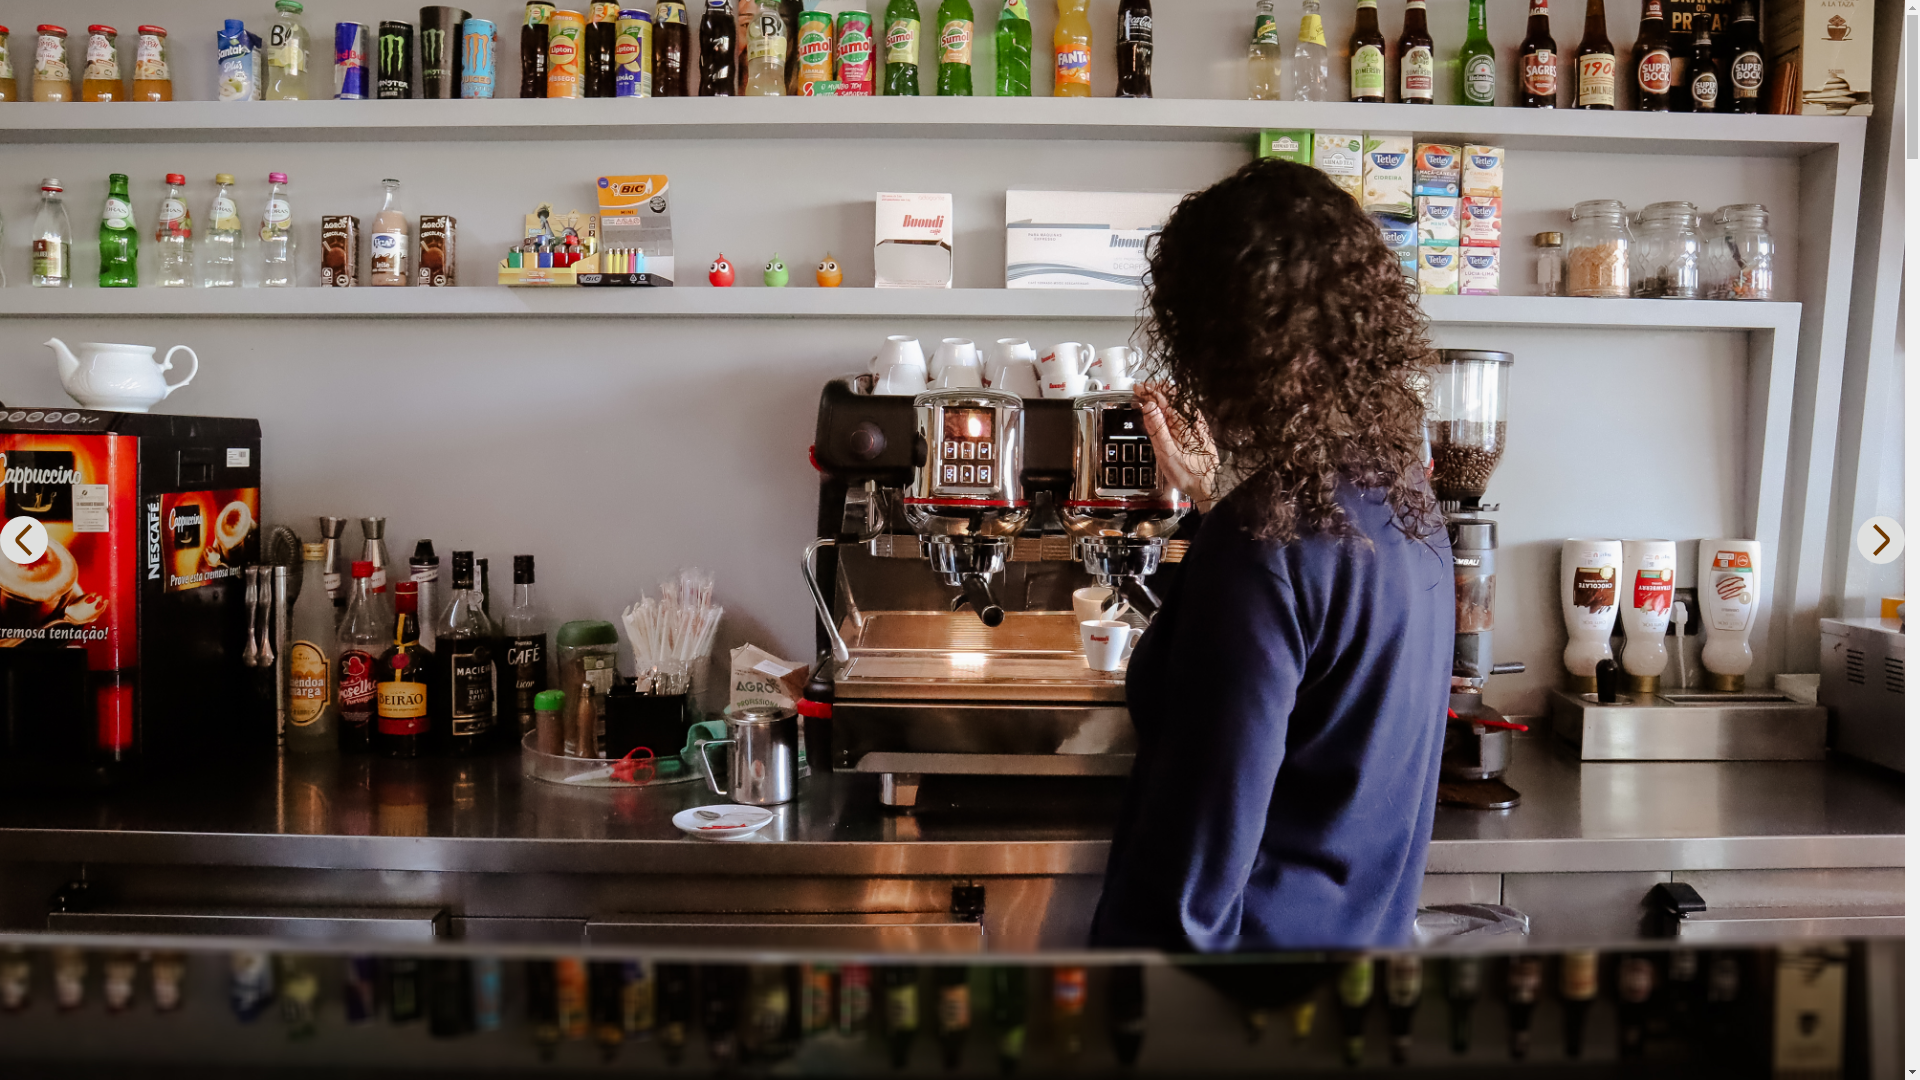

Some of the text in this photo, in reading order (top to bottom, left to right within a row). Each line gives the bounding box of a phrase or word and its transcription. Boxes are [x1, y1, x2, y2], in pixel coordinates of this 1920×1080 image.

[886, 30, 914, 47] Sumol
[941, 31, 970, 48] Sumol
[551, 45, 573, 54] Lipton
[1058, 50, 1088, 66] FANTA
[223, 61, 243, 73] Plus
[1525, 64, 1557, 78] SAGRES
[1642, 63, 1671, 73] SUPER
[1735, 63, 1761, 73] SUPER
[1643, 72, 1670, 82] BOCK
[1736, 71, 1761, 80] BOCK
[1696, 87, 1716, 95] BOCK
[1375, 154, 1402, 166] Tetley
[1429, 155, 1450, 166] Tetley
[1474, 157, 1495, 167] Tetley
[1430, 207, 1450, 217] Tetley
[1472, 207, 1493, 217] Tetley
[323, 221, 347, 229] AGROS
[421, 221, 445, 229] AGROS
[903, 214, 945, 228] Buondi
[322, 231, 348, 239] CHOCOLATE
[420, 231, 446, 239] CHOCOLATE
[1382, 232, 1408, 244] Tetley
[1429, 256, 1449, 266] Tetley
[1469, 257, 1490, 267] Tetley
[147, 502, 160, 580] NESCAFÉ
[170, 573, 189, 587] Prove
[190, 571, 203, 582] esta
[204, 567, 229, 581] cremosa
[1578, 581, 1613, 590] CHOCOLATE
[50, 625, 109, 644] tentação!
[507, 644, 541, 666] CAFÉ
[735, 680, 782, 695] AGROS
[379, 692, 424, 706] BEIRÃO
